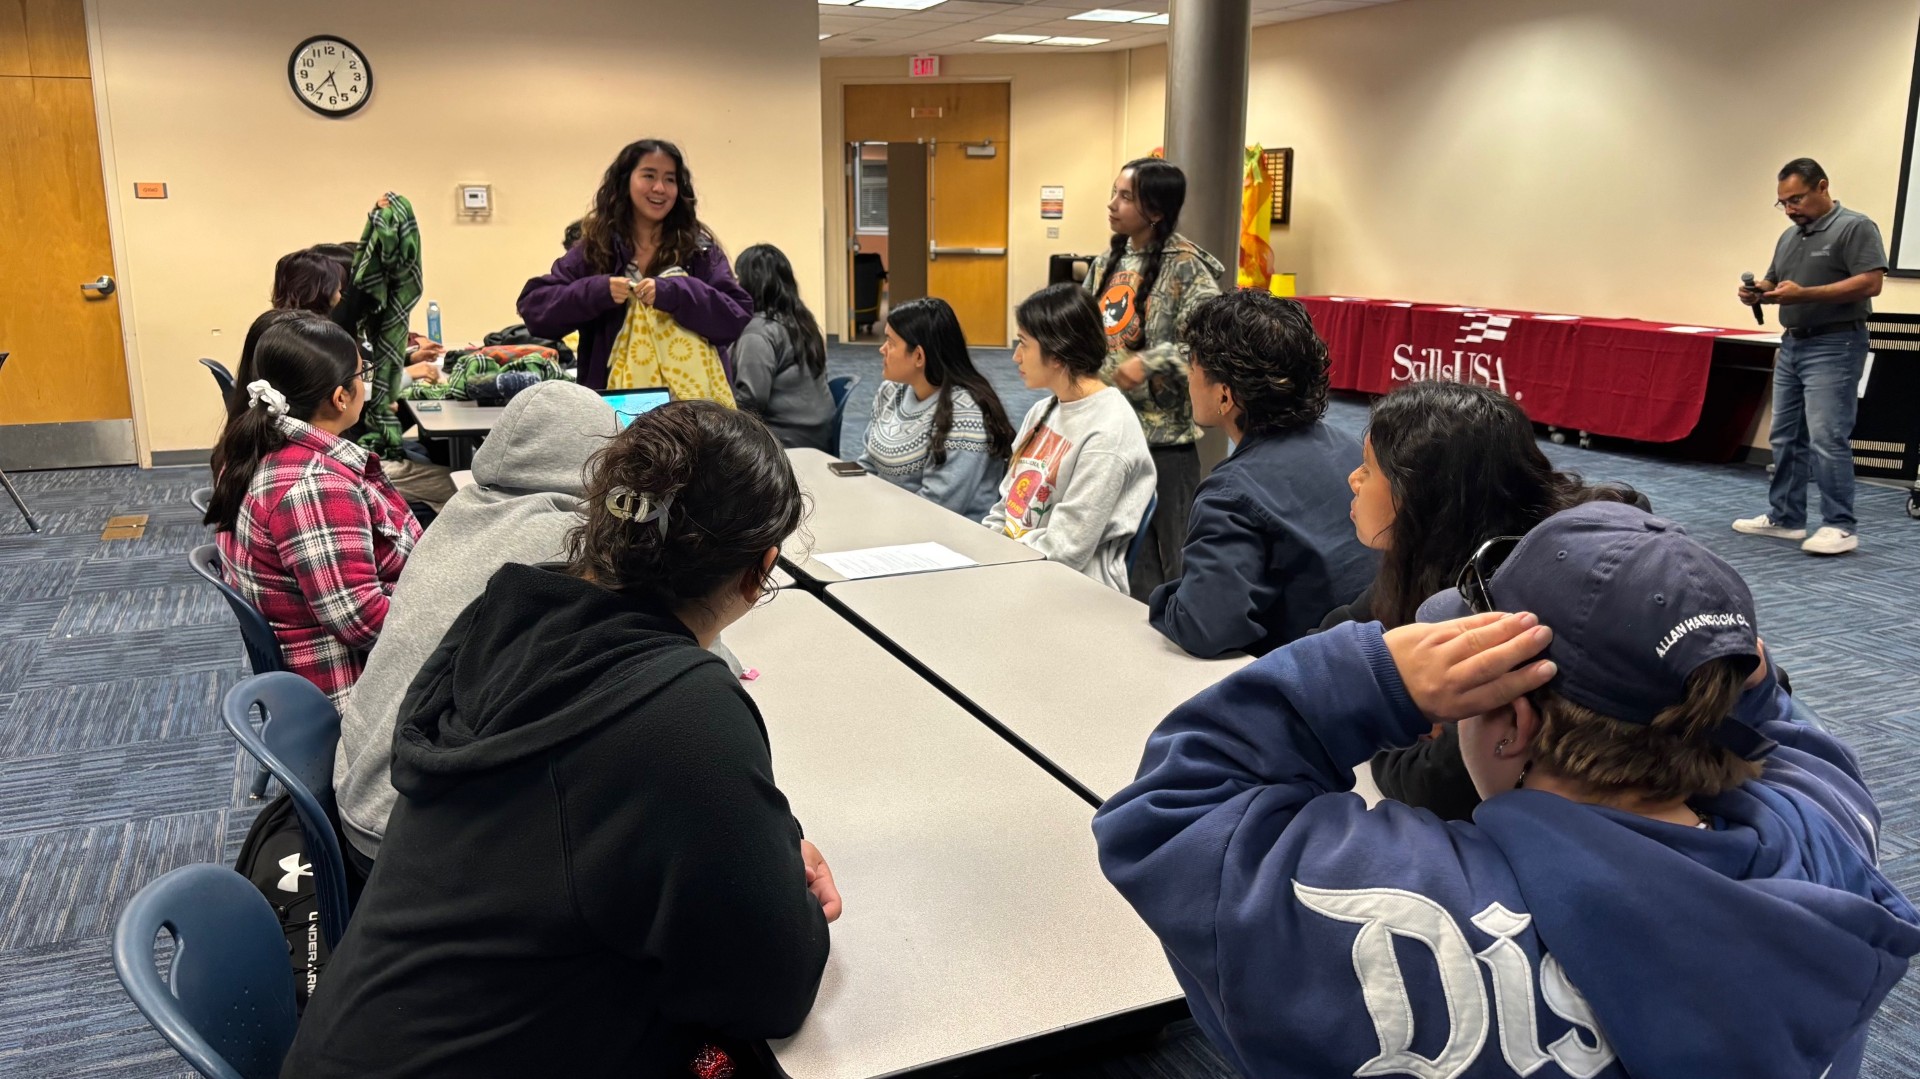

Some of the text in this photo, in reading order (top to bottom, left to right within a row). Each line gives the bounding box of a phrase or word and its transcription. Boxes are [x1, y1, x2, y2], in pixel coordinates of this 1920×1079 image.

[312, 49, 321, 58] 11
[324, 46, 335, 55] 12
[302, 58, 314, 67] 10
[349, 60, 357, 69] 2
[300, 69, 308, 79] 9
[353, 72, 361, 81] 3
[305, 82, 314, 92] 8
[349, 85, 358, 93] 4
[316, 91, 323, 100] 7
[340, 93, 349, 101] 5
[329, 96, 337, 105] 6
[1655, 622, 1688, 658] ALLAN
[1684, 612, 1737, 632] HANCOCK
